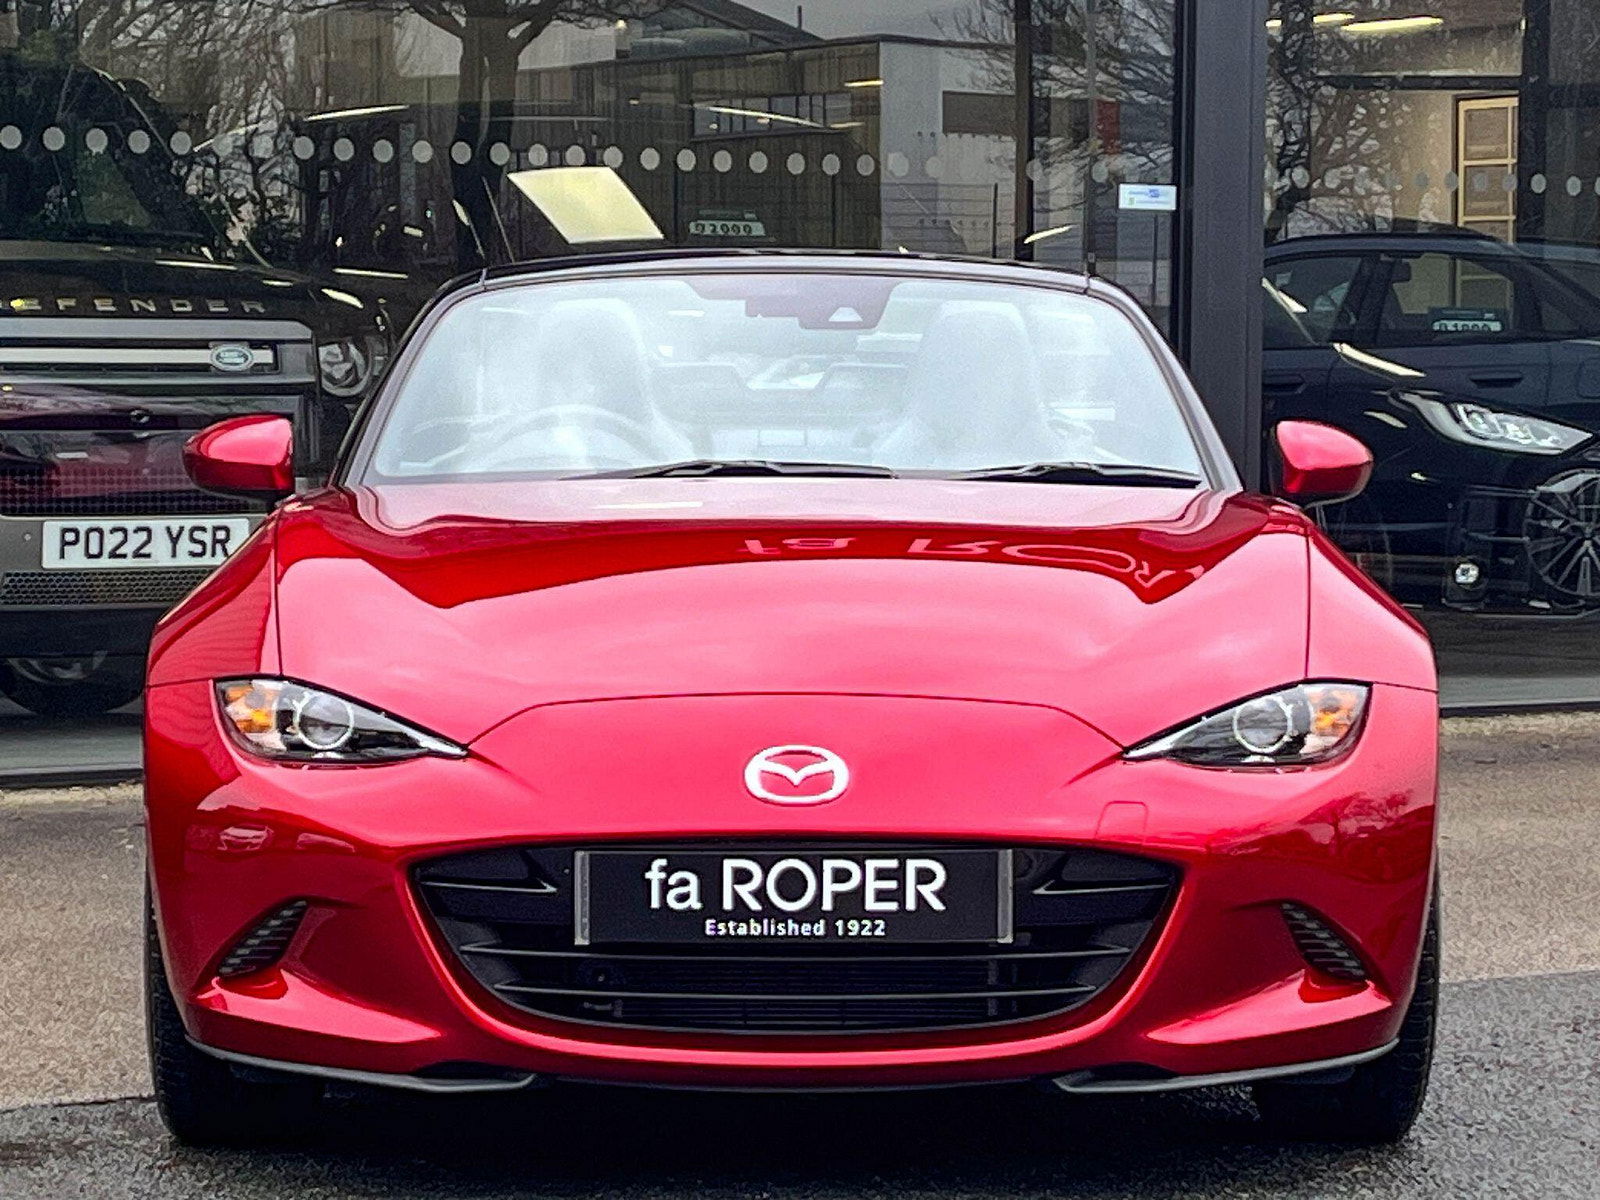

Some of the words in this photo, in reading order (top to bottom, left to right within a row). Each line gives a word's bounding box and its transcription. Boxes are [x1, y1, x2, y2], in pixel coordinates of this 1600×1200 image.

[0, 298, 266, 313] EFENDER
[59, 526, 153, 560] PO22
[165, 525, 232, 558] YSR
[644, 858, 703, 911] fa
[722, 858, 947, 912] ROPER
[704, 918, 826, 936] Established
[834, 919, 886, 936] 1922
